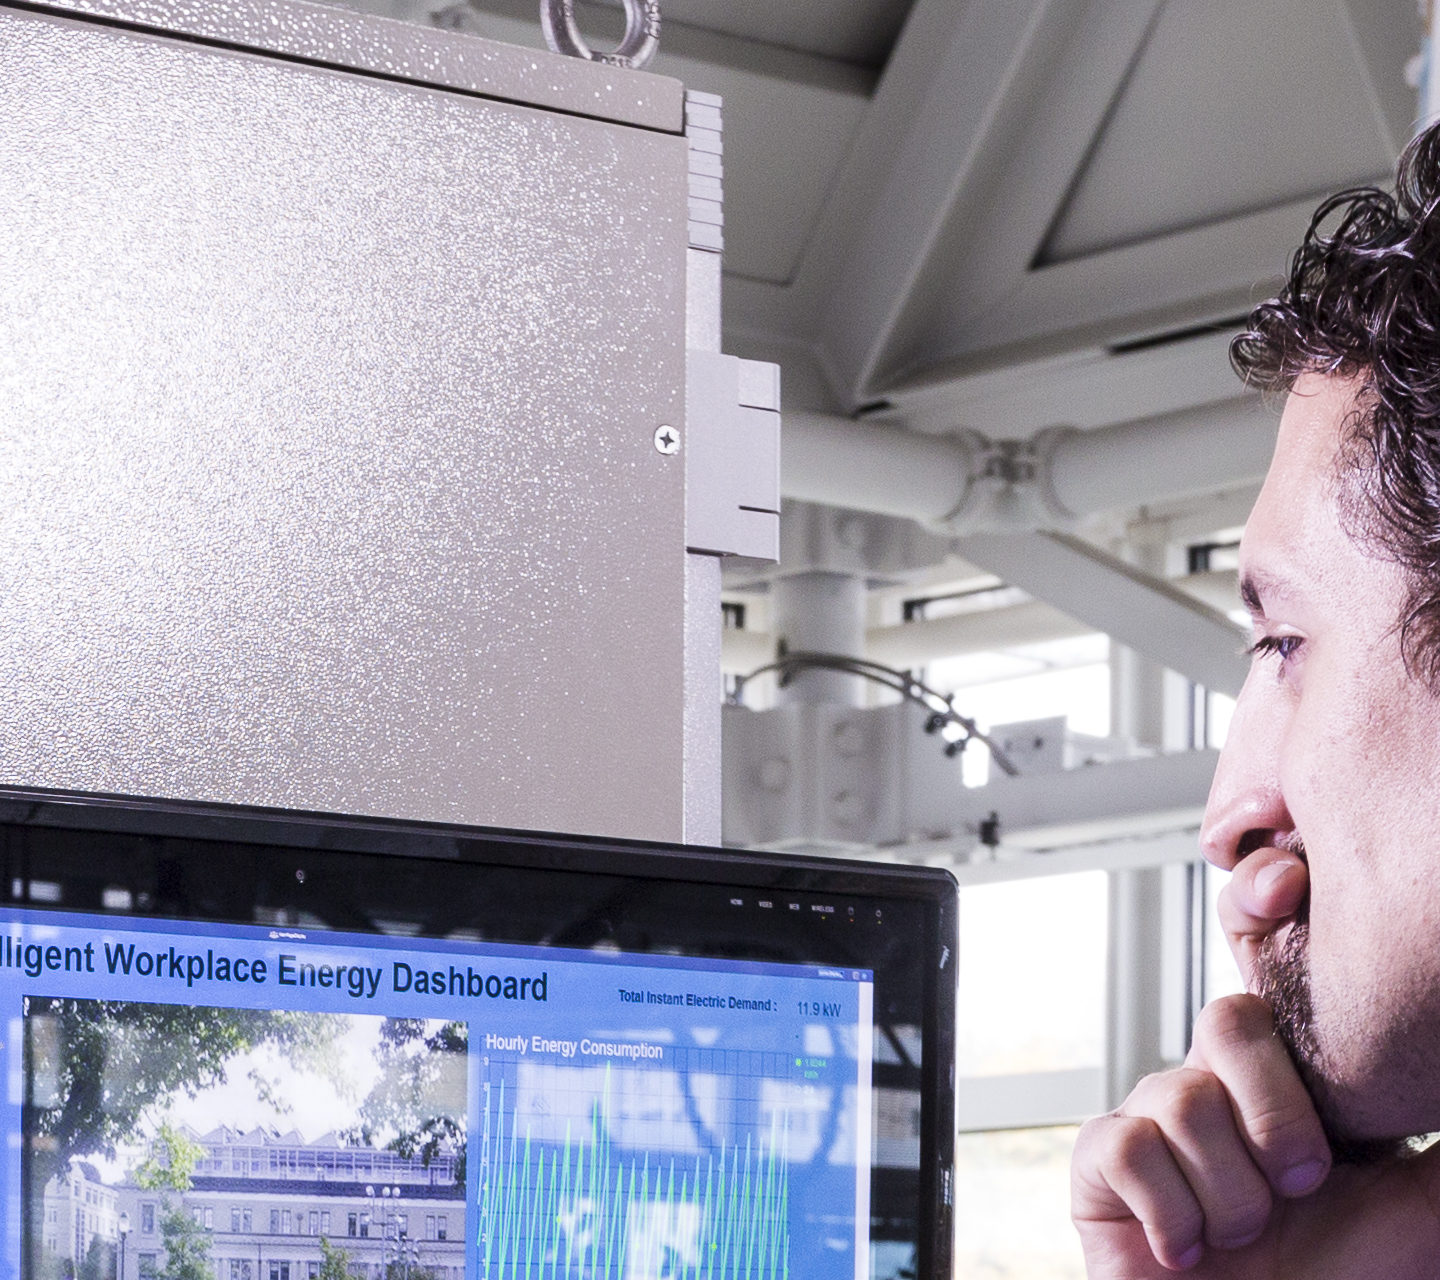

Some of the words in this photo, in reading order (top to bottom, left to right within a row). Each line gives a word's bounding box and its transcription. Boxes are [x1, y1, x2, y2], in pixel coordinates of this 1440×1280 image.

[759, 901, 773, 909] VIDEO
[104, 942, 267, 988] Workplace
[278, 954, 383, 999] Energy
[392, 961, 548, 1001] Dashboard
[619, 989, 644, 1004] Total
[647, 991, 683, 1006] Instant
[686, 993, 725, 1009] Electric
[729, 996, 771, 1011] Demand
[797, 1001, 820, 1016] 11.9
[822, 1002, 841, 1018] kW
[486, 1033, 529, 1056] Hourly
[532, 1035, 577, 1059] Energy
[580, 1038, 663, 1061] Consumption
